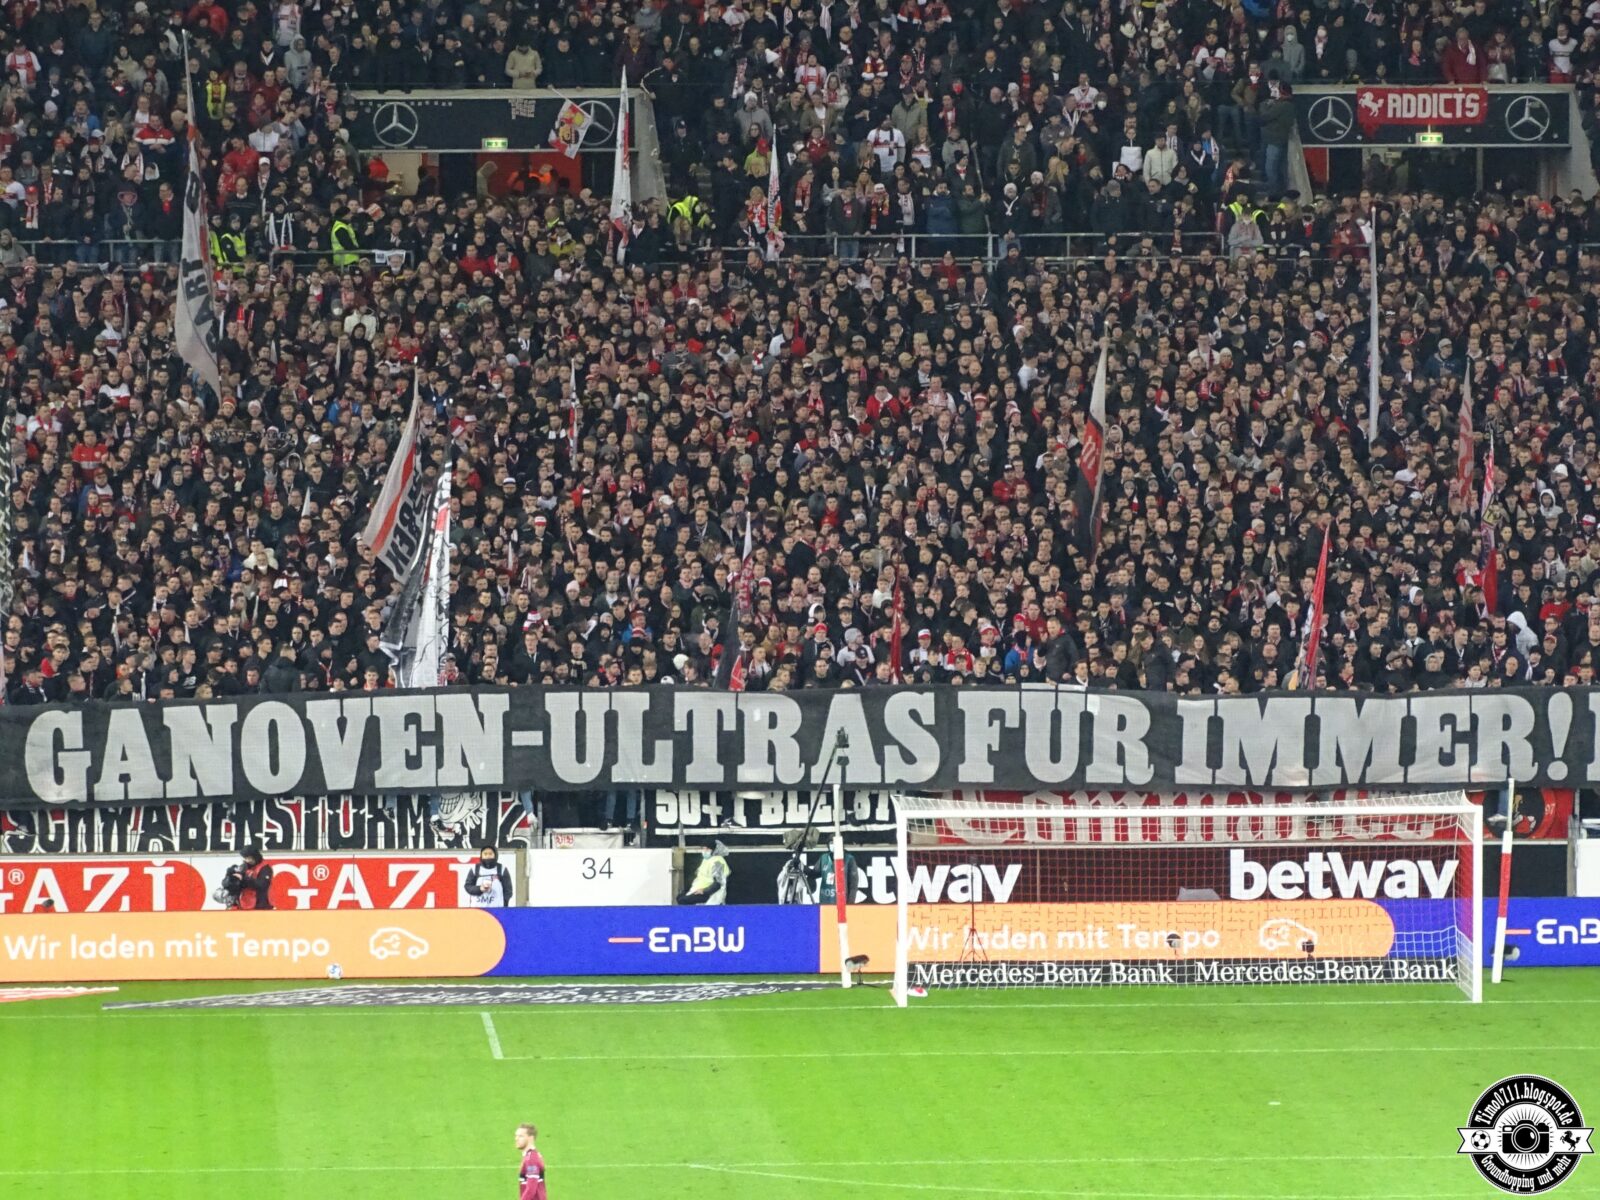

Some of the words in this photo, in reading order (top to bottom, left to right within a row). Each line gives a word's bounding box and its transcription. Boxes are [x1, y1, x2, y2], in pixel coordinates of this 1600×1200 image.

[1386, 92, 1480, 118] ADDICTS
[25, 690, 942, 804] GANOVEN-ULTRAS
[957, 682, 1155, 786] FÜR
[1174, 691, 1574, 788] IMMER!
[582, 857, 614, 880] 34
[1229, 849, 1459, 901] betway
[4, 935, 61, 960] Wir
[70, 933, 154, 959] laden
[165, 932, 217, 958] mit
[226, 931, 331, 963] Tempo
[648, 926, 745, 953] EnBW
[903, 926, 953, 950] Wir
[963, 924, 1048, 950] laden
[1057, 924, 1110, 949] mit
[915, 961, 1101, 985] Mercedes-Benz
[1109, 960, 1175, 984] Bank
[1195, 960, 1383, 982] Mercedes-Benz
[1393, 959, 1458, 981] Bank
